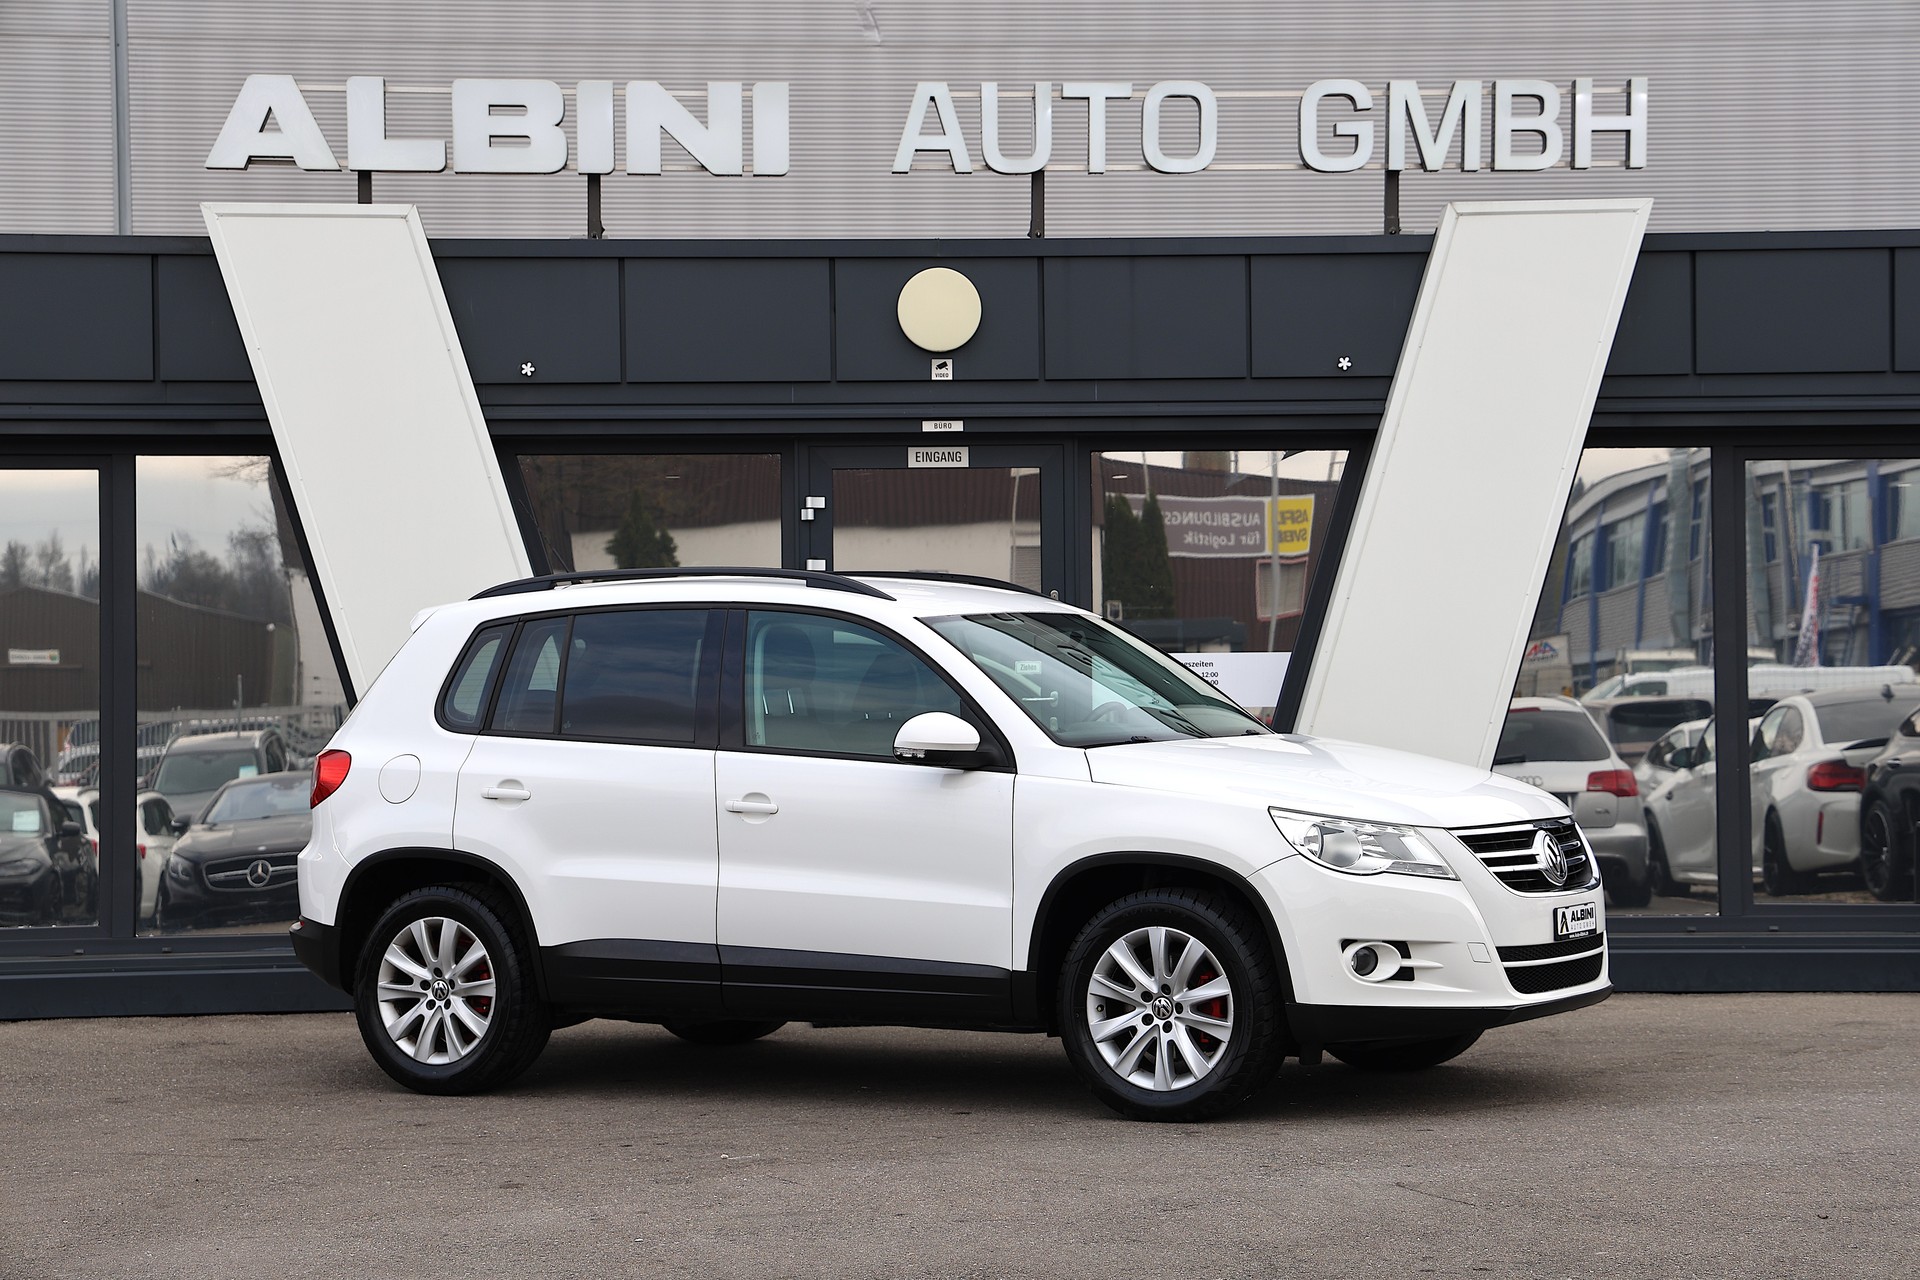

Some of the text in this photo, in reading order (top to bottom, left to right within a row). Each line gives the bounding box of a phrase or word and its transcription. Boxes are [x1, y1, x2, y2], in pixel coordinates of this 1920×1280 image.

[205, 74, 1648, 177] ALBINI AUTO GMBH
[933, 421, 952, 429] BÜRO
[915, 451, 962, 463] EINGANG
[1570, 907, 1594, 922] ALBINI
